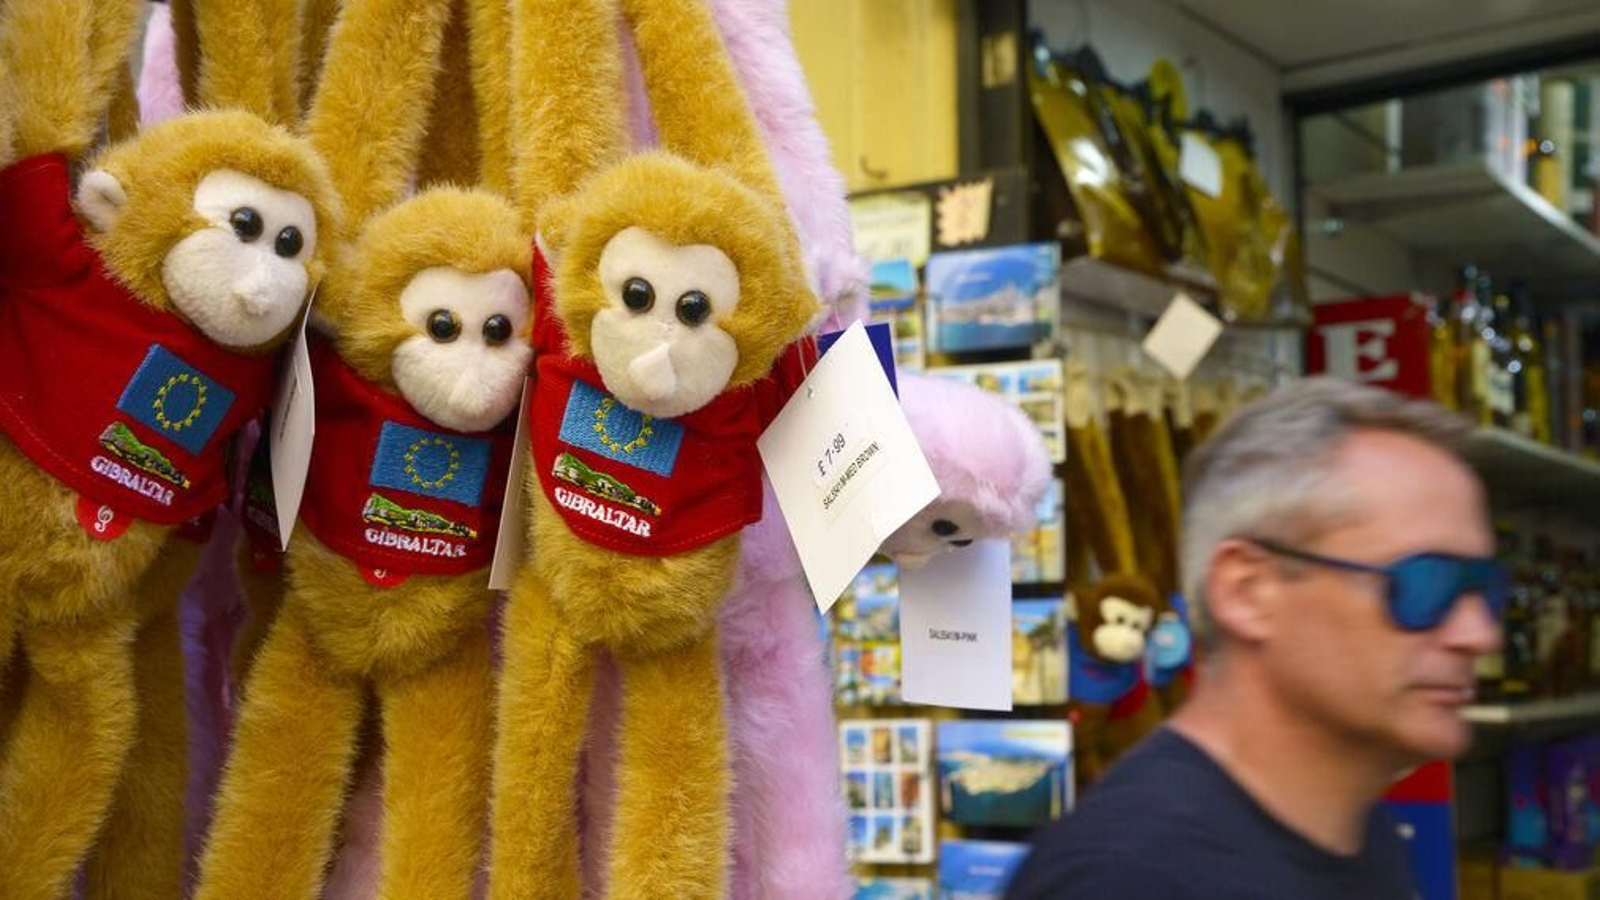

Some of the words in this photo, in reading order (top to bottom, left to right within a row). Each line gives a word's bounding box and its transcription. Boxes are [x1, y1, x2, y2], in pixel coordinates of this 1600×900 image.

[856, 441, 880, 469] BROWN
[91, 455, 175, 506] GIBRALTAR
[554, 486, 652, 538] GIBRALTAR
[364, 528, 467, 557] GIBRALTAR
